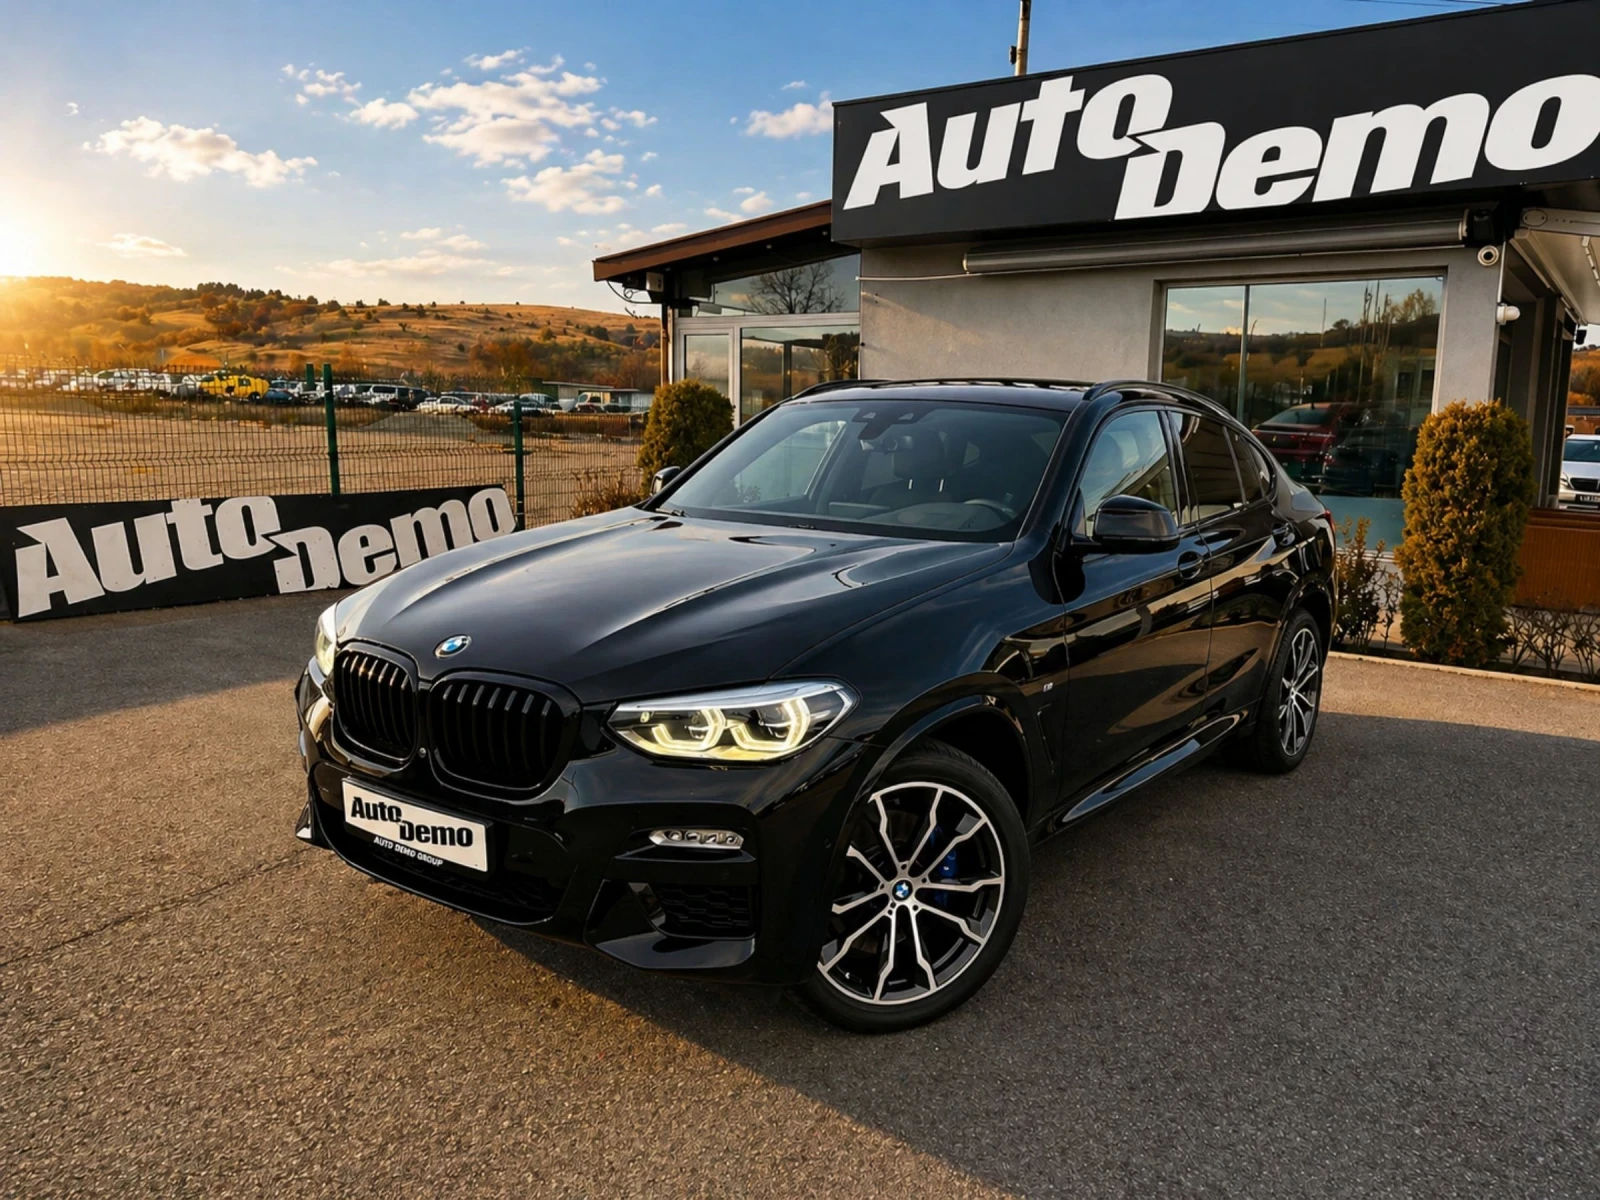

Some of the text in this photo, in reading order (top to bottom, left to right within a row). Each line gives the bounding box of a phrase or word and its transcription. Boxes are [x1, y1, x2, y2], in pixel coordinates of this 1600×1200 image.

[842, 73, 1600, 221] Auto Demo
[15, 487, 517, 618] Auto Demo
[351, 796, 474, 848] Auto Demo
[373, 836, 444, 866] AUTO DEMO GROUP
